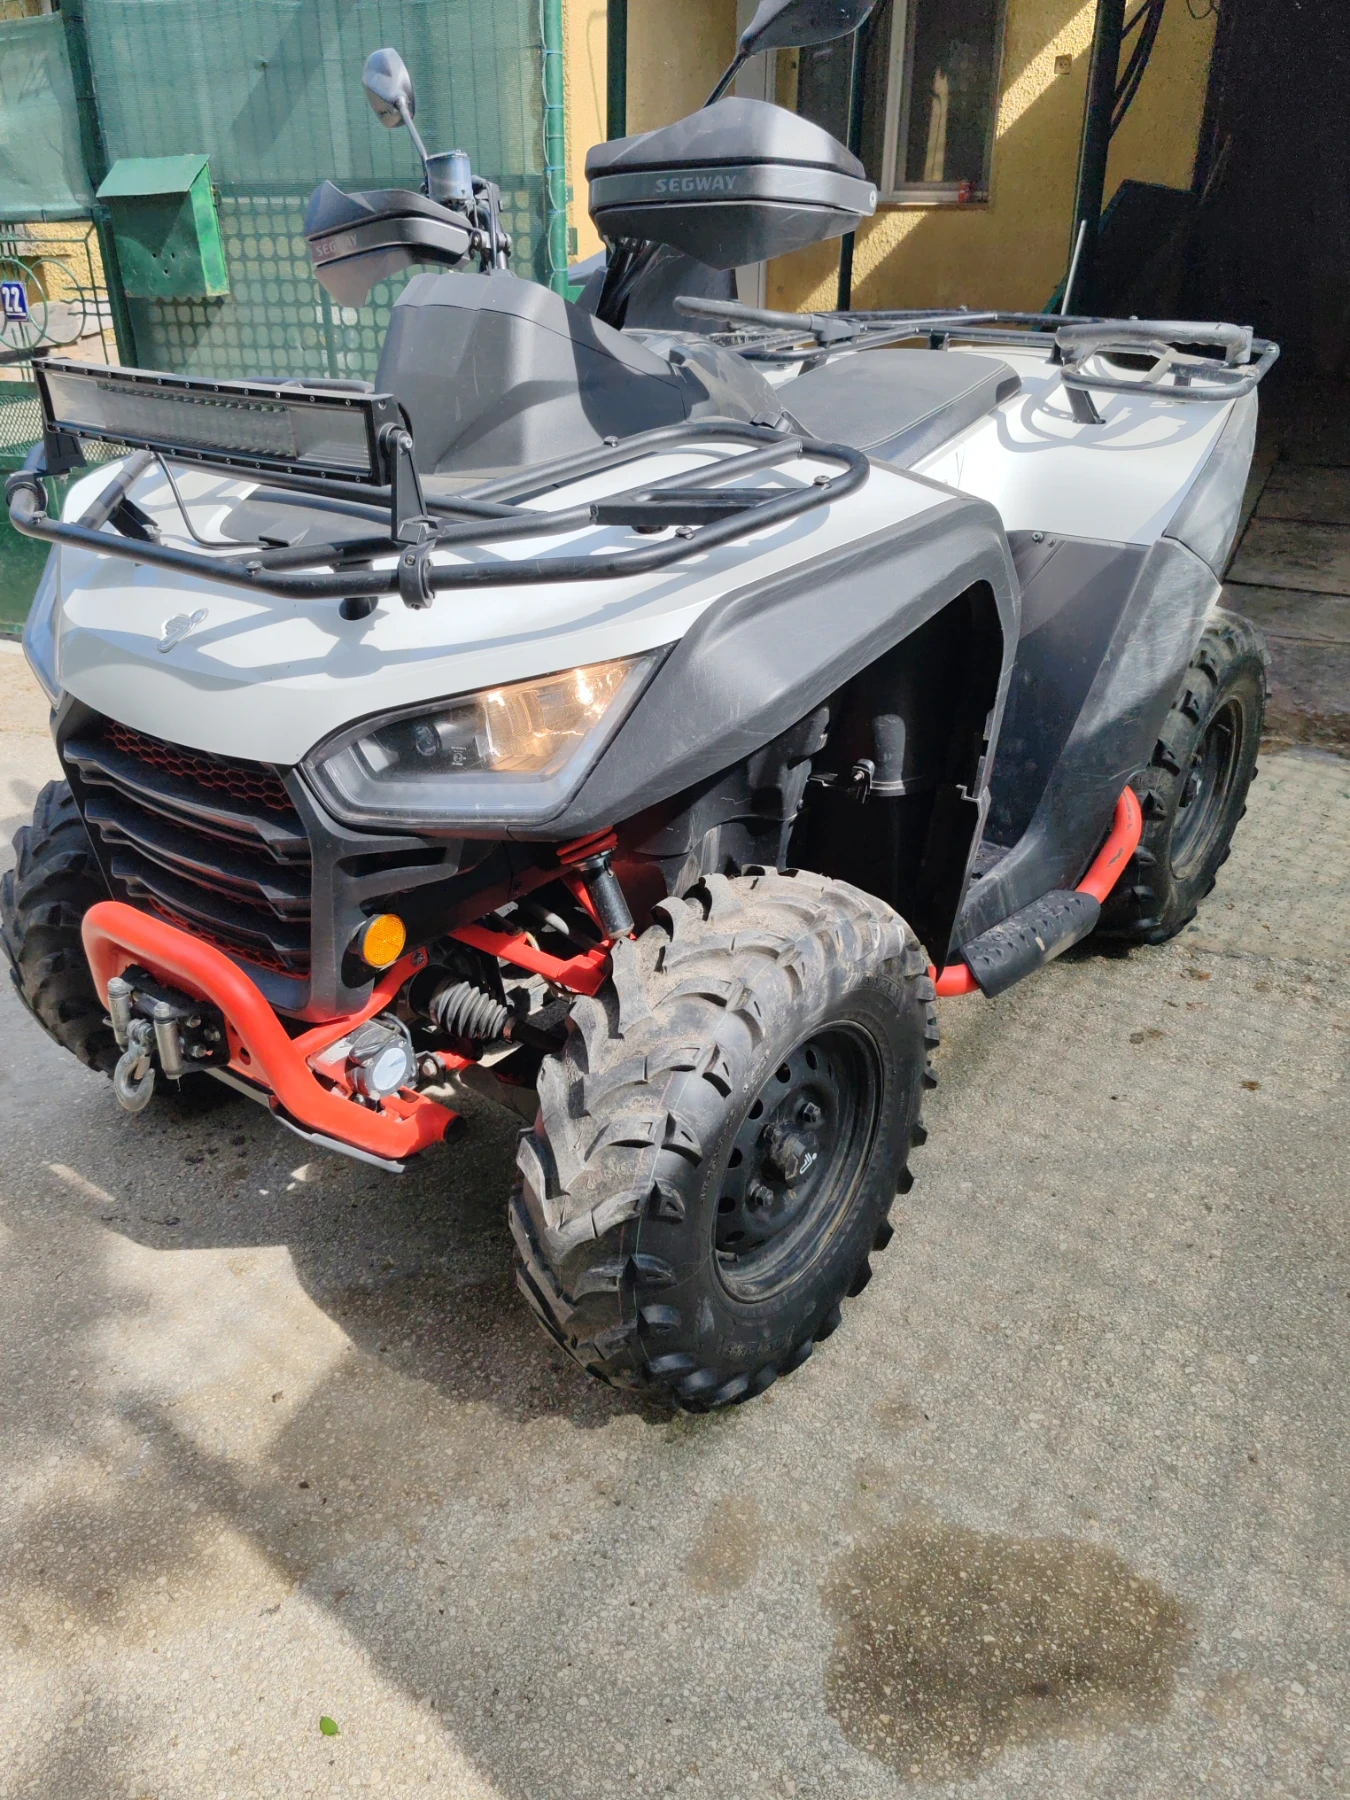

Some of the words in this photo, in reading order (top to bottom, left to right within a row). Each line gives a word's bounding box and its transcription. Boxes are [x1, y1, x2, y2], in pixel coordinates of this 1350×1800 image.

[655, 175, 738, 194] SEGWAY
[315, 234, 358, 257] SEGAY
[2, 286, 24, 313] 22
